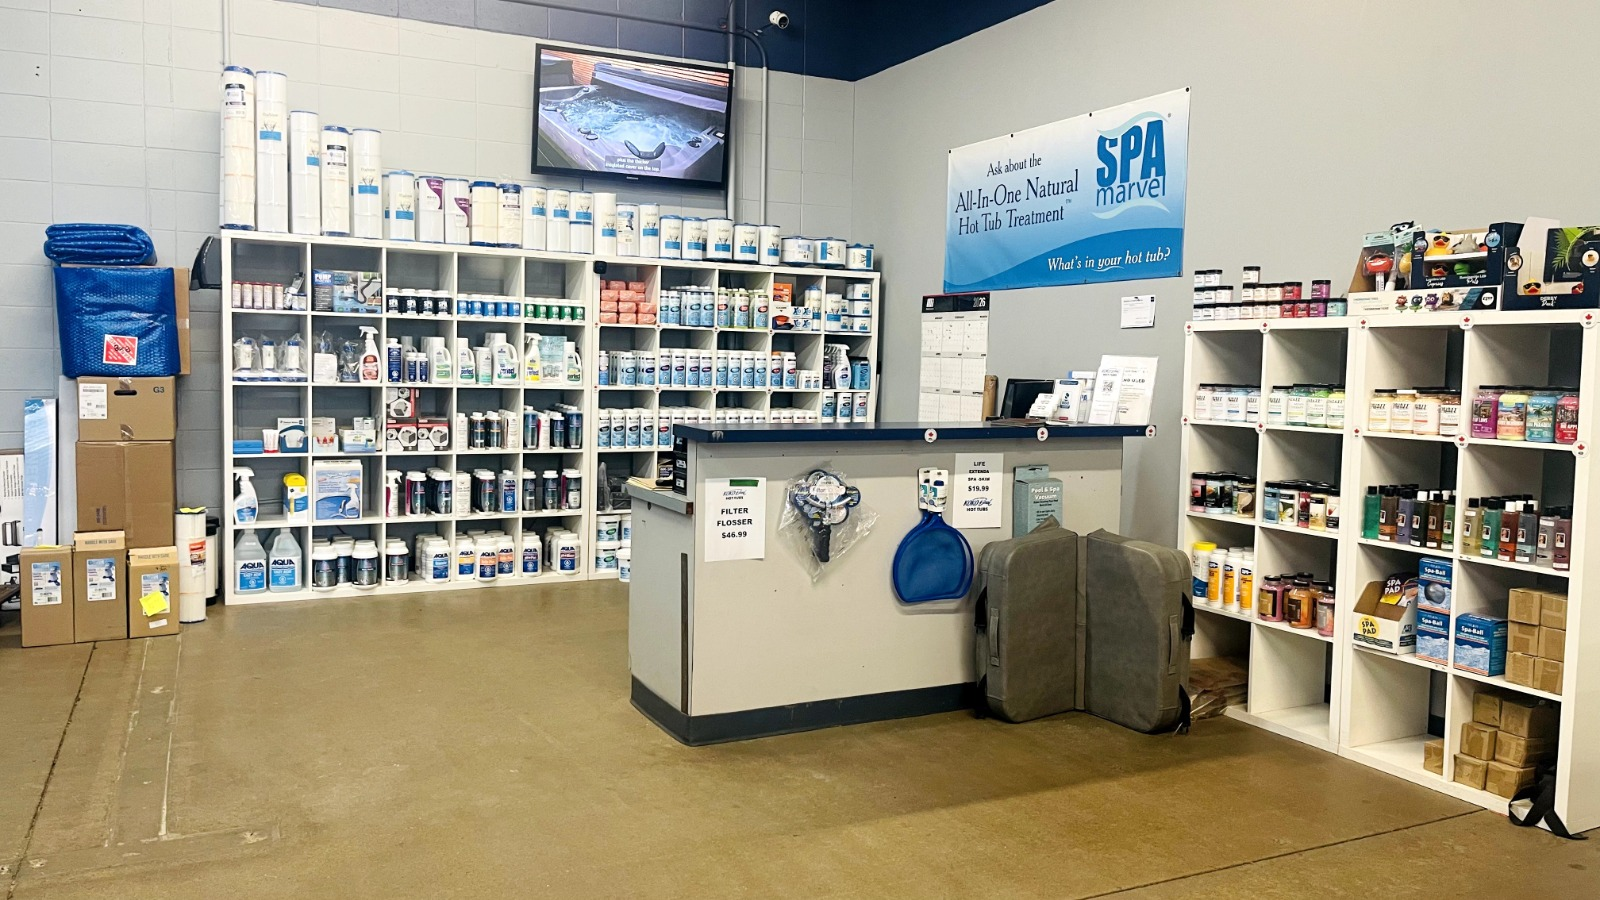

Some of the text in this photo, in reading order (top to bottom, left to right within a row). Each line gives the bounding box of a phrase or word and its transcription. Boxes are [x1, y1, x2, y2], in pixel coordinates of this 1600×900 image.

[987, 153, 1042, 177] Ask about the
[1096, 119, 1166, 187] SPA
[955, 169, 1079, 213] All-In-One Natural
[1096, 176, 1166, 206] marvel
[958, 216, 979, 235] Hot
[981, 212, 1002, 232] Tub
[1006, 206, 1064, 228] Treatment
[1048, 247, 1171, 271] What's in your hot tub?
[1425, 567, 1446, 576] Spa-Ball
[1384, 586, 1400, 595] PAD
[1422, 617, 1442, 626] Spa-Ball
[1461, 626, 1484, 635] Spa-Ball
